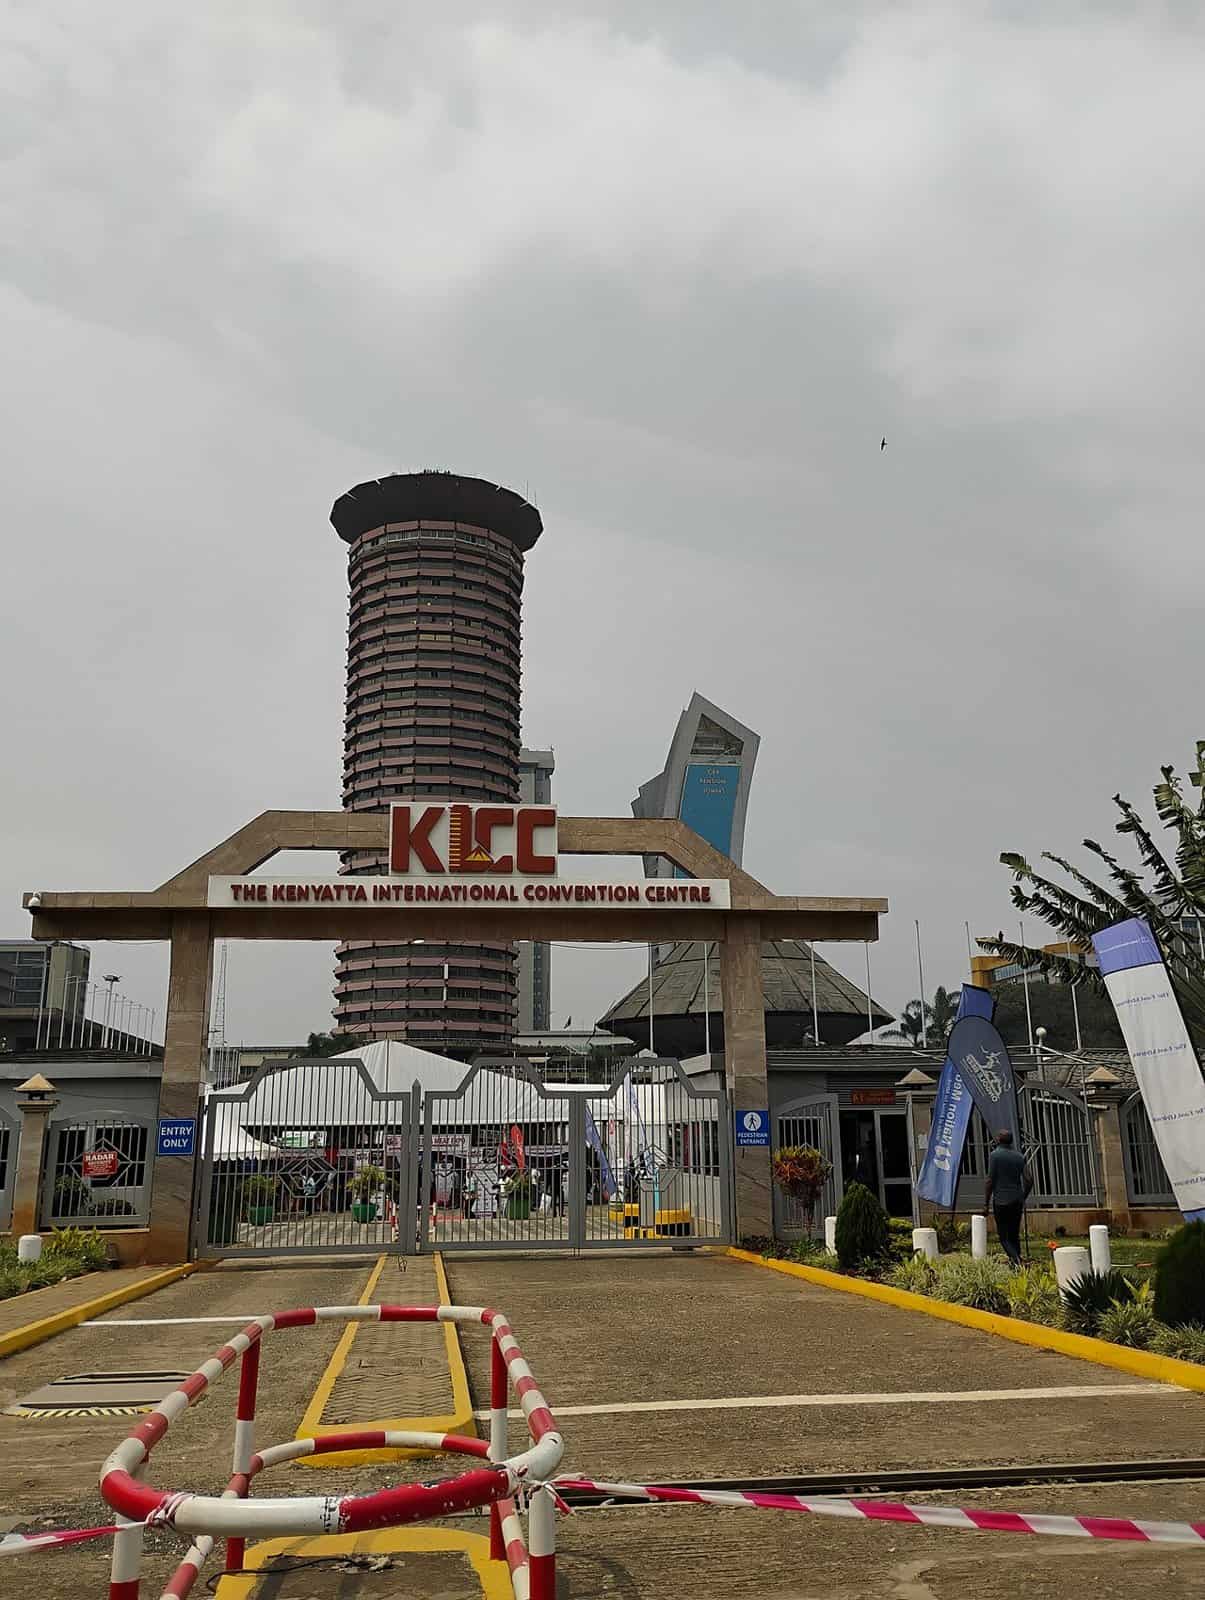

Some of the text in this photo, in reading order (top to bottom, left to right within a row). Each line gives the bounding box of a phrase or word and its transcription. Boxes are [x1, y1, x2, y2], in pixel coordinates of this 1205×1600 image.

[391, 805, 556, 873] KICC
[231, 884, 711, 903] THE KENYATTA INTERNATIONAL CONVENTION CENTRE
[161, 1126, 193, 1136] ENTRY
[163, 1138, 189, 1148] ONLY
[85, 1153, 114, 1162] RADAR
